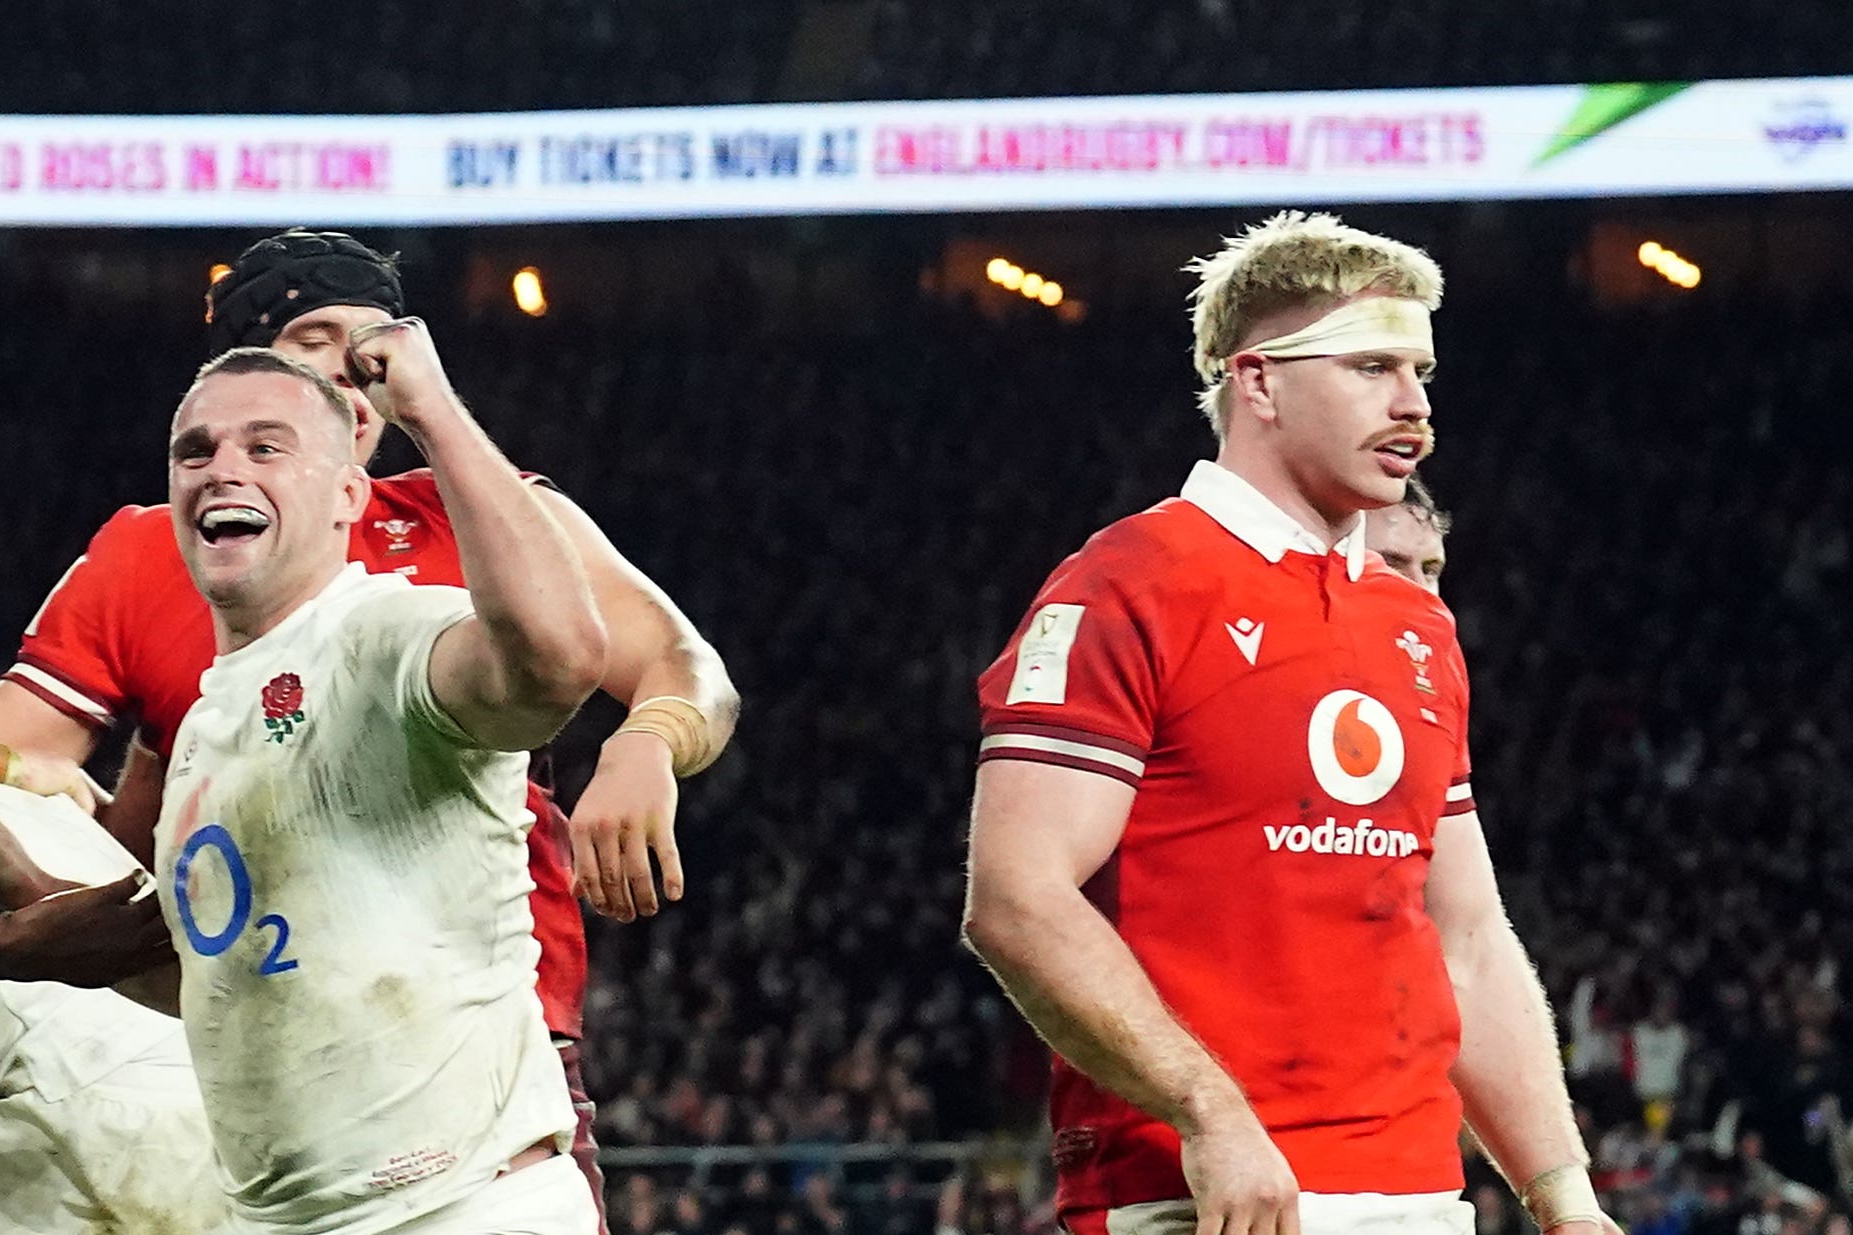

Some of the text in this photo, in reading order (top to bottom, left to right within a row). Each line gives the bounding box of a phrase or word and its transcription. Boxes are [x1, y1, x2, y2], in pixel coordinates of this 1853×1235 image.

[40, 141, 167, 191] ROSES
[183, 142, 219, 191] IN
[448, 136, 519, 188] BUY
[540, 131, 693, 184] TICKETS
[709, 127, 801, 178] NOW
[815, 126, 858, 175] AT
[174, 824, 299, 977] O2
